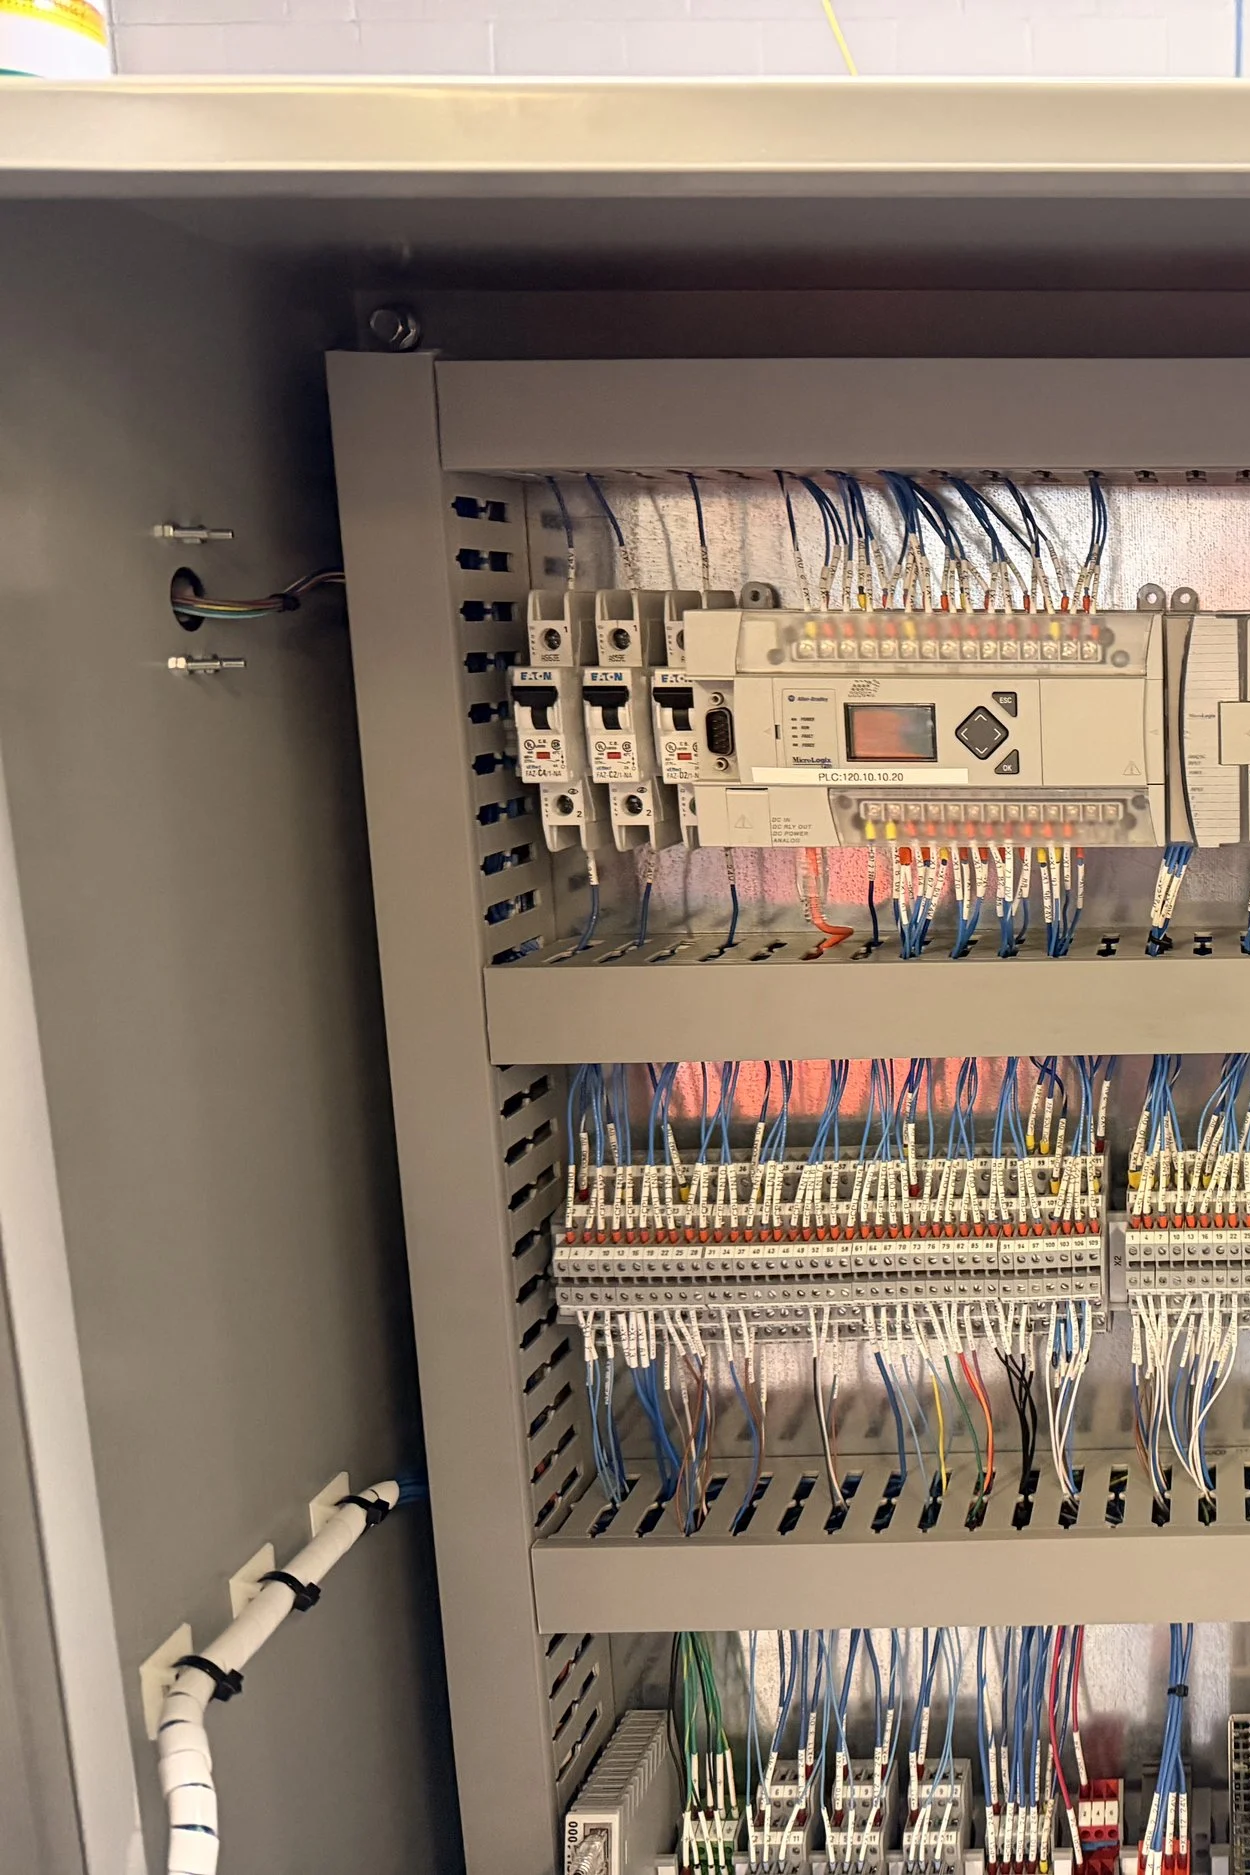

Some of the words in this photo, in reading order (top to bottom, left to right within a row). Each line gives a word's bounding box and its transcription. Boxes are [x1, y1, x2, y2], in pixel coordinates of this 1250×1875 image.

[999, 696, 1013, 704] ESC
[792, 756, 831, 764] MicroLogix
[1002, 764, 1013, 772] OK
[667, 771, 699, 779] FAZ-D2/1-N
[818, 773, 904, 782] PLC:120.10.10.20
[576, 810, 583, 818] 2
[646, 809, 652, 817] 2
[1114, 1255, 1122, 1267] X2
